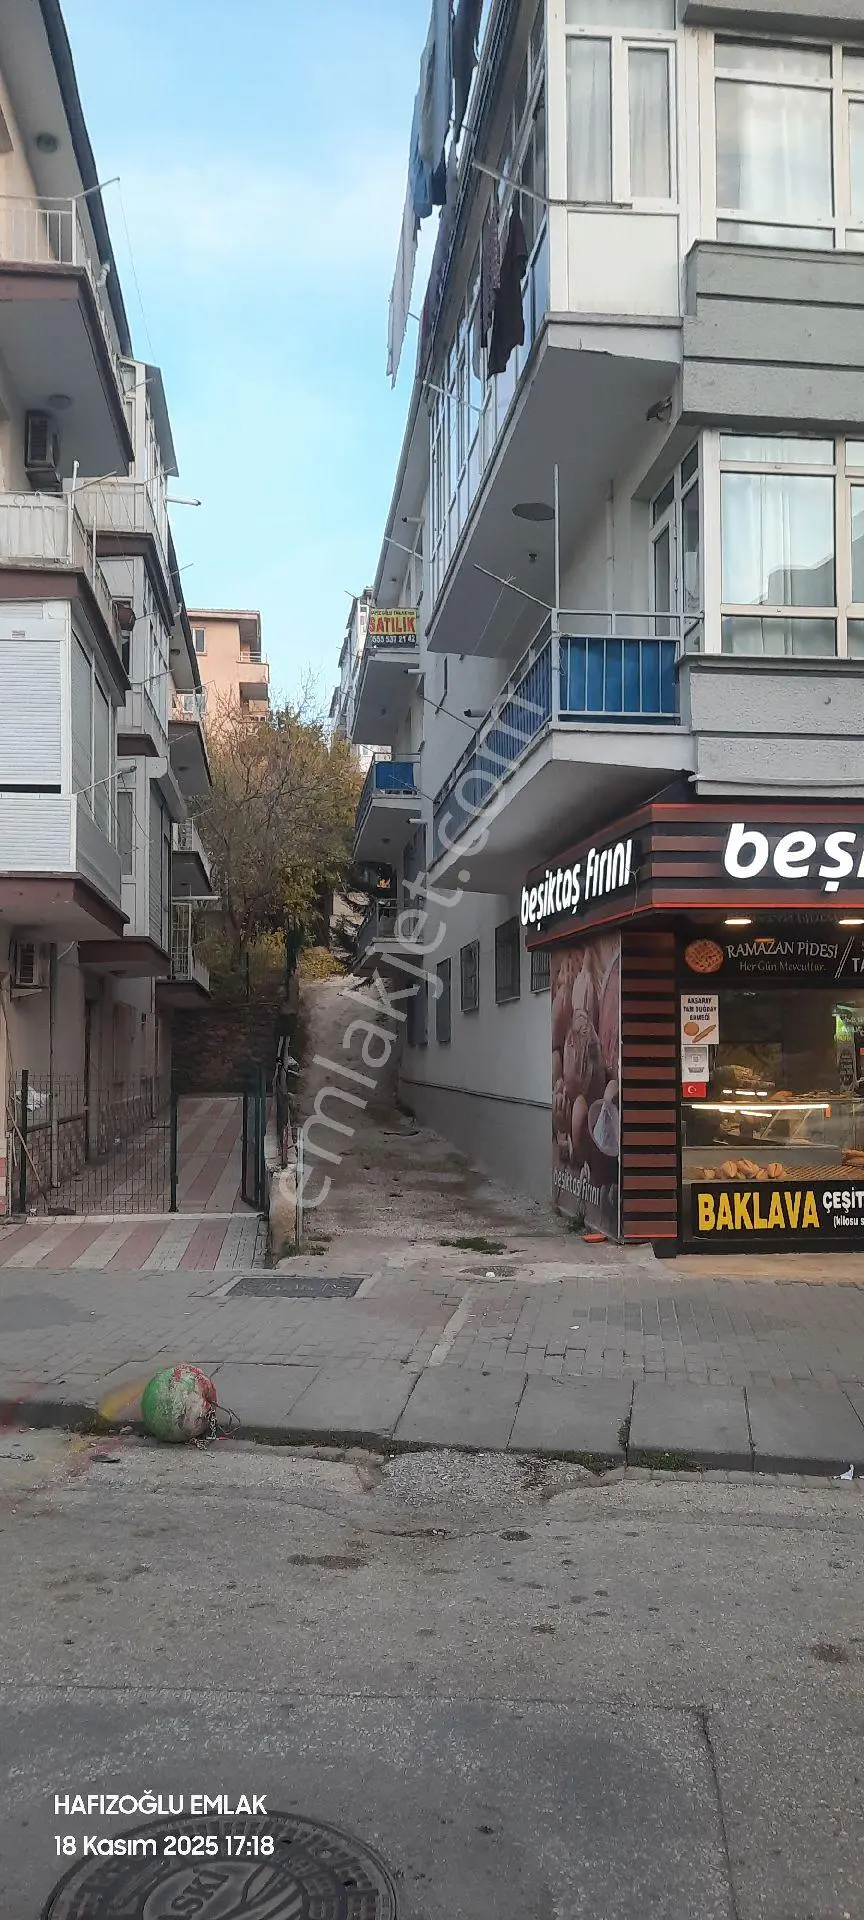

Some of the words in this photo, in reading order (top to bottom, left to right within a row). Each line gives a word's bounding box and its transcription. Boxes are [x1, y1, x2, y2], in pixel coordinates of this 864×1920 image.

[369, 616, 416, 633] SATILIK
[724, 823, 864, 892] beş
[520, 863, 581, 931] beşiktaş
[584, 838, 633, 900] fırını
[726, 940, 794, 959] RAMAZAN
[740, 961, 756, 971] Her
[697, 1190, 821, 1231] BAKLAVA
